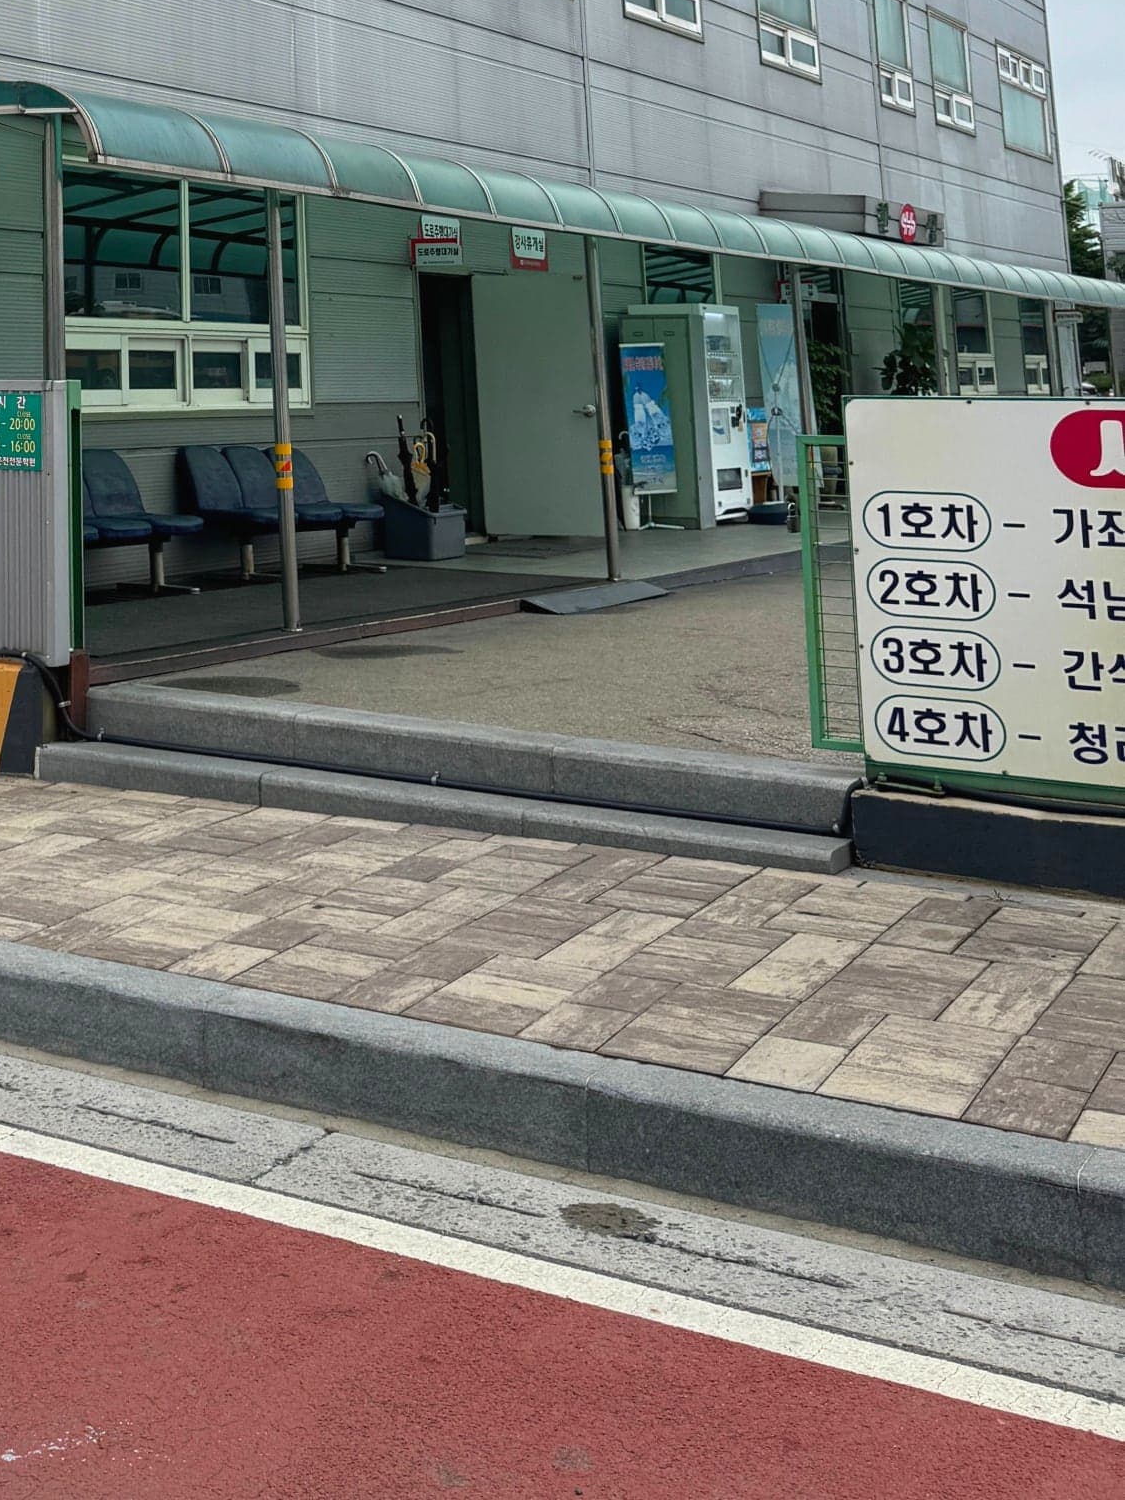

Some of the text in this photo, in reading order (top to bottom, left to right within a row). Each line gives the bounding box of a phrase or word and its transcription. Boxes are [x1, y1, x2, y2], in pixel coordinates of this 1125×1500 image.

[9, 417, 36, 431] 20:00
[10, 440, 36, 453] 16:00
[876, 502, 978, 543] 1호차
[879, 569, 983, 613] 2호차
[882, 636, 988, 683] 3호차
[887, 706, 993, 753] 4호차
[1069, 721, 1125, 765] 청
